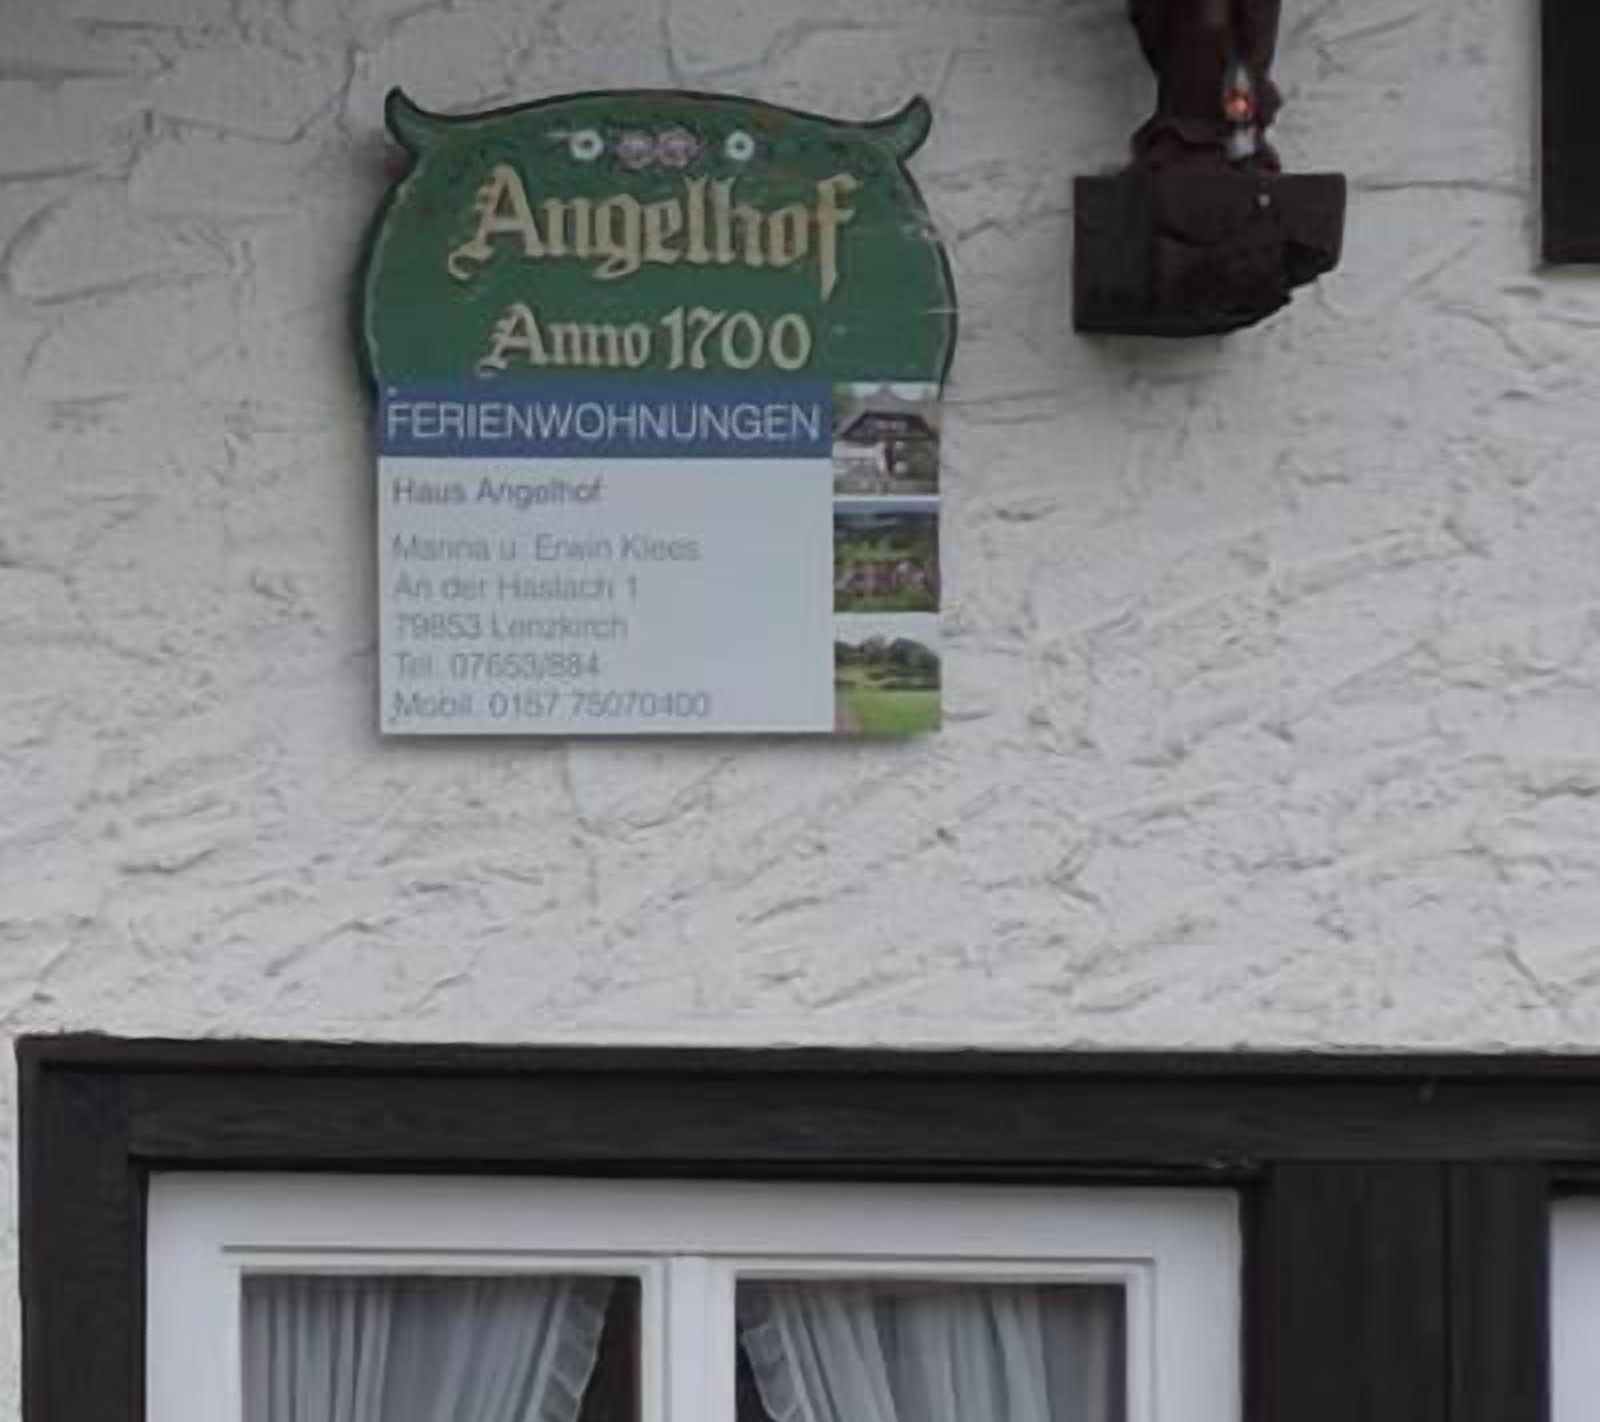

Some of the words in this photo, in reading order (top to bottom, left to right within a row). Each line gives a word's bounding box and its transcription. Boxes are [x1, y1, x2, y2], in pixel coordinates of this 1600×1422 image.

[447, 162, 860, 304] Angelhof
[476, 302, 651, 377] Anno
[660, 305, 811, 370] 1700
[387, 401, 821, 442] FERIENWOHNUNGEN
[392, 477, 467, 503] Haus
[477, 476, 603, 511] Angelhof
[394, 573, 432, 598] An
[440, 573, 486, 599] der
[394, 613, 482, 639] 79853
